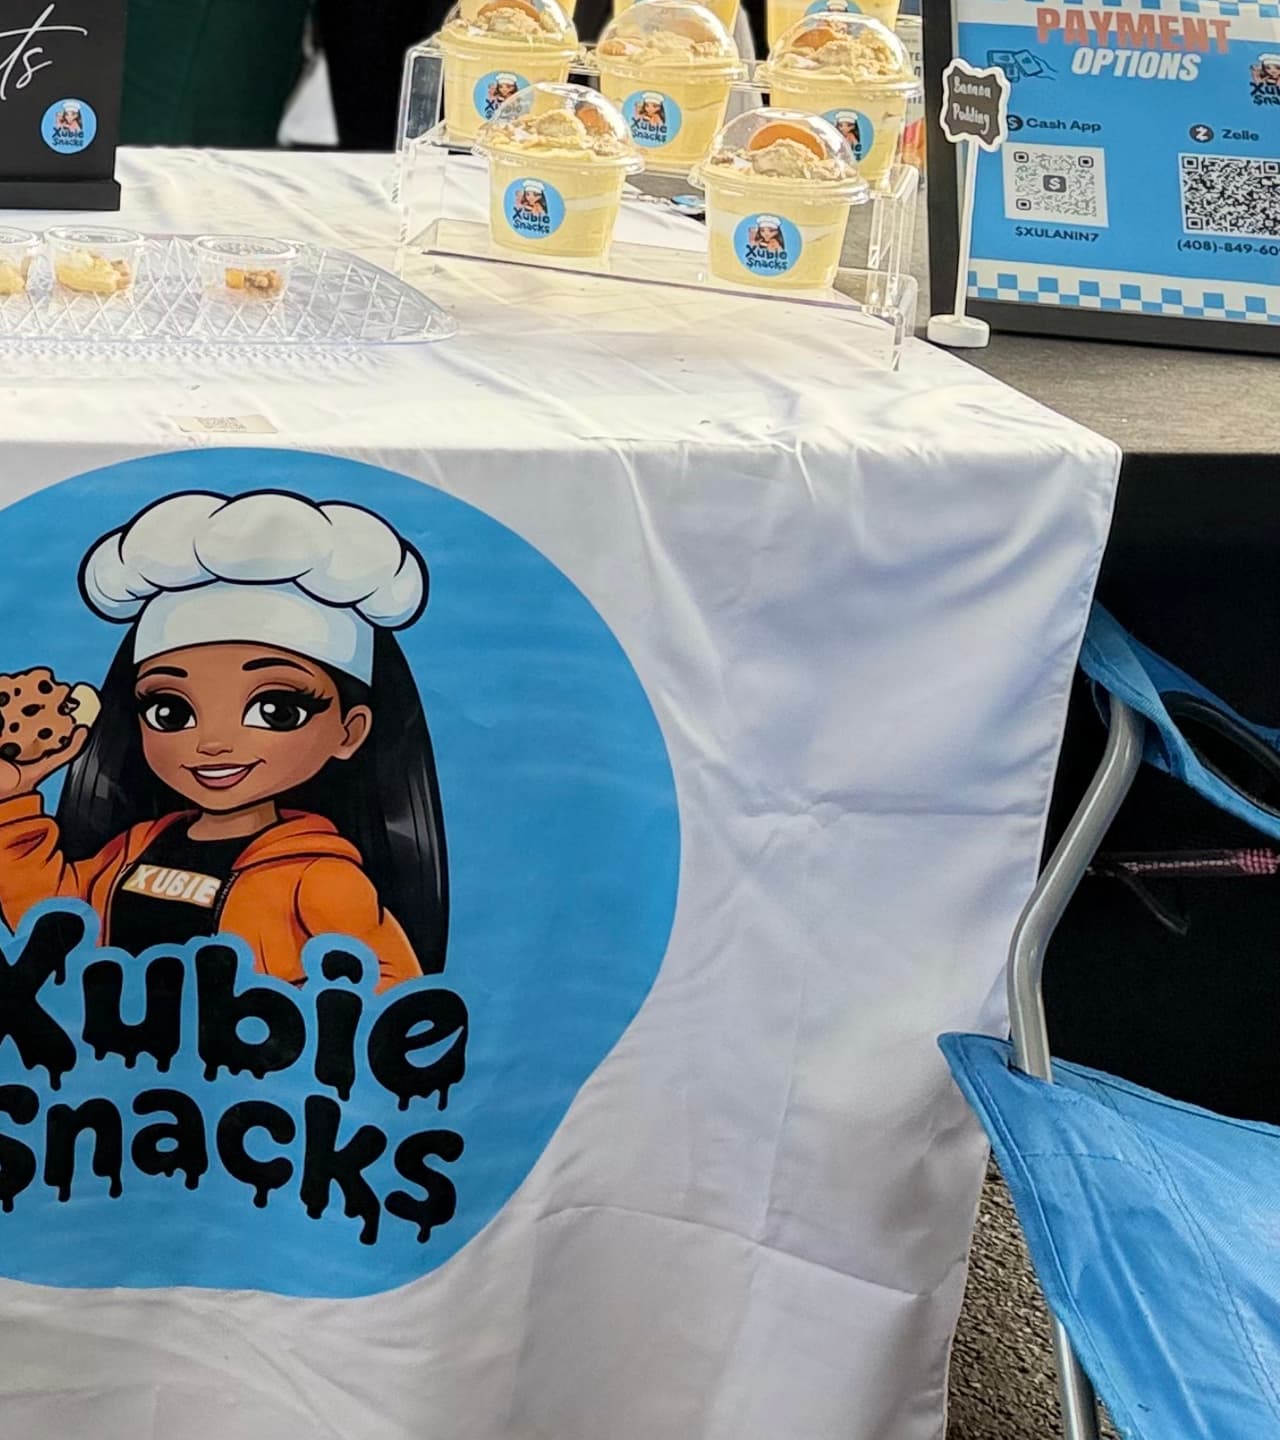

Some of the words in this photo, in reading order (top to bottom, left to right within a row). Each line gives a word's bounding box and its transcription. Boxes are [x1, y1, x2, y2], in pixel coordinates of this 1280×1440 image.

[1036, 6, 1231, 55] PAYMENT
[1071, 46, 1202, 82] OPTIONS
[1253, 94, 1280, 106] Sna
[1026, 117, 1067, 131] Cash
[1070, 120, 1102, 134] App
[1221, 128, 1260, 142] Zelle
[745, 244, 788, 260] Xubie
[1177, 239, 1280, 256] (408)-849-60
[746, 257, 788, 271] Snacks
[129, 865, 221, 906] XUBIE
